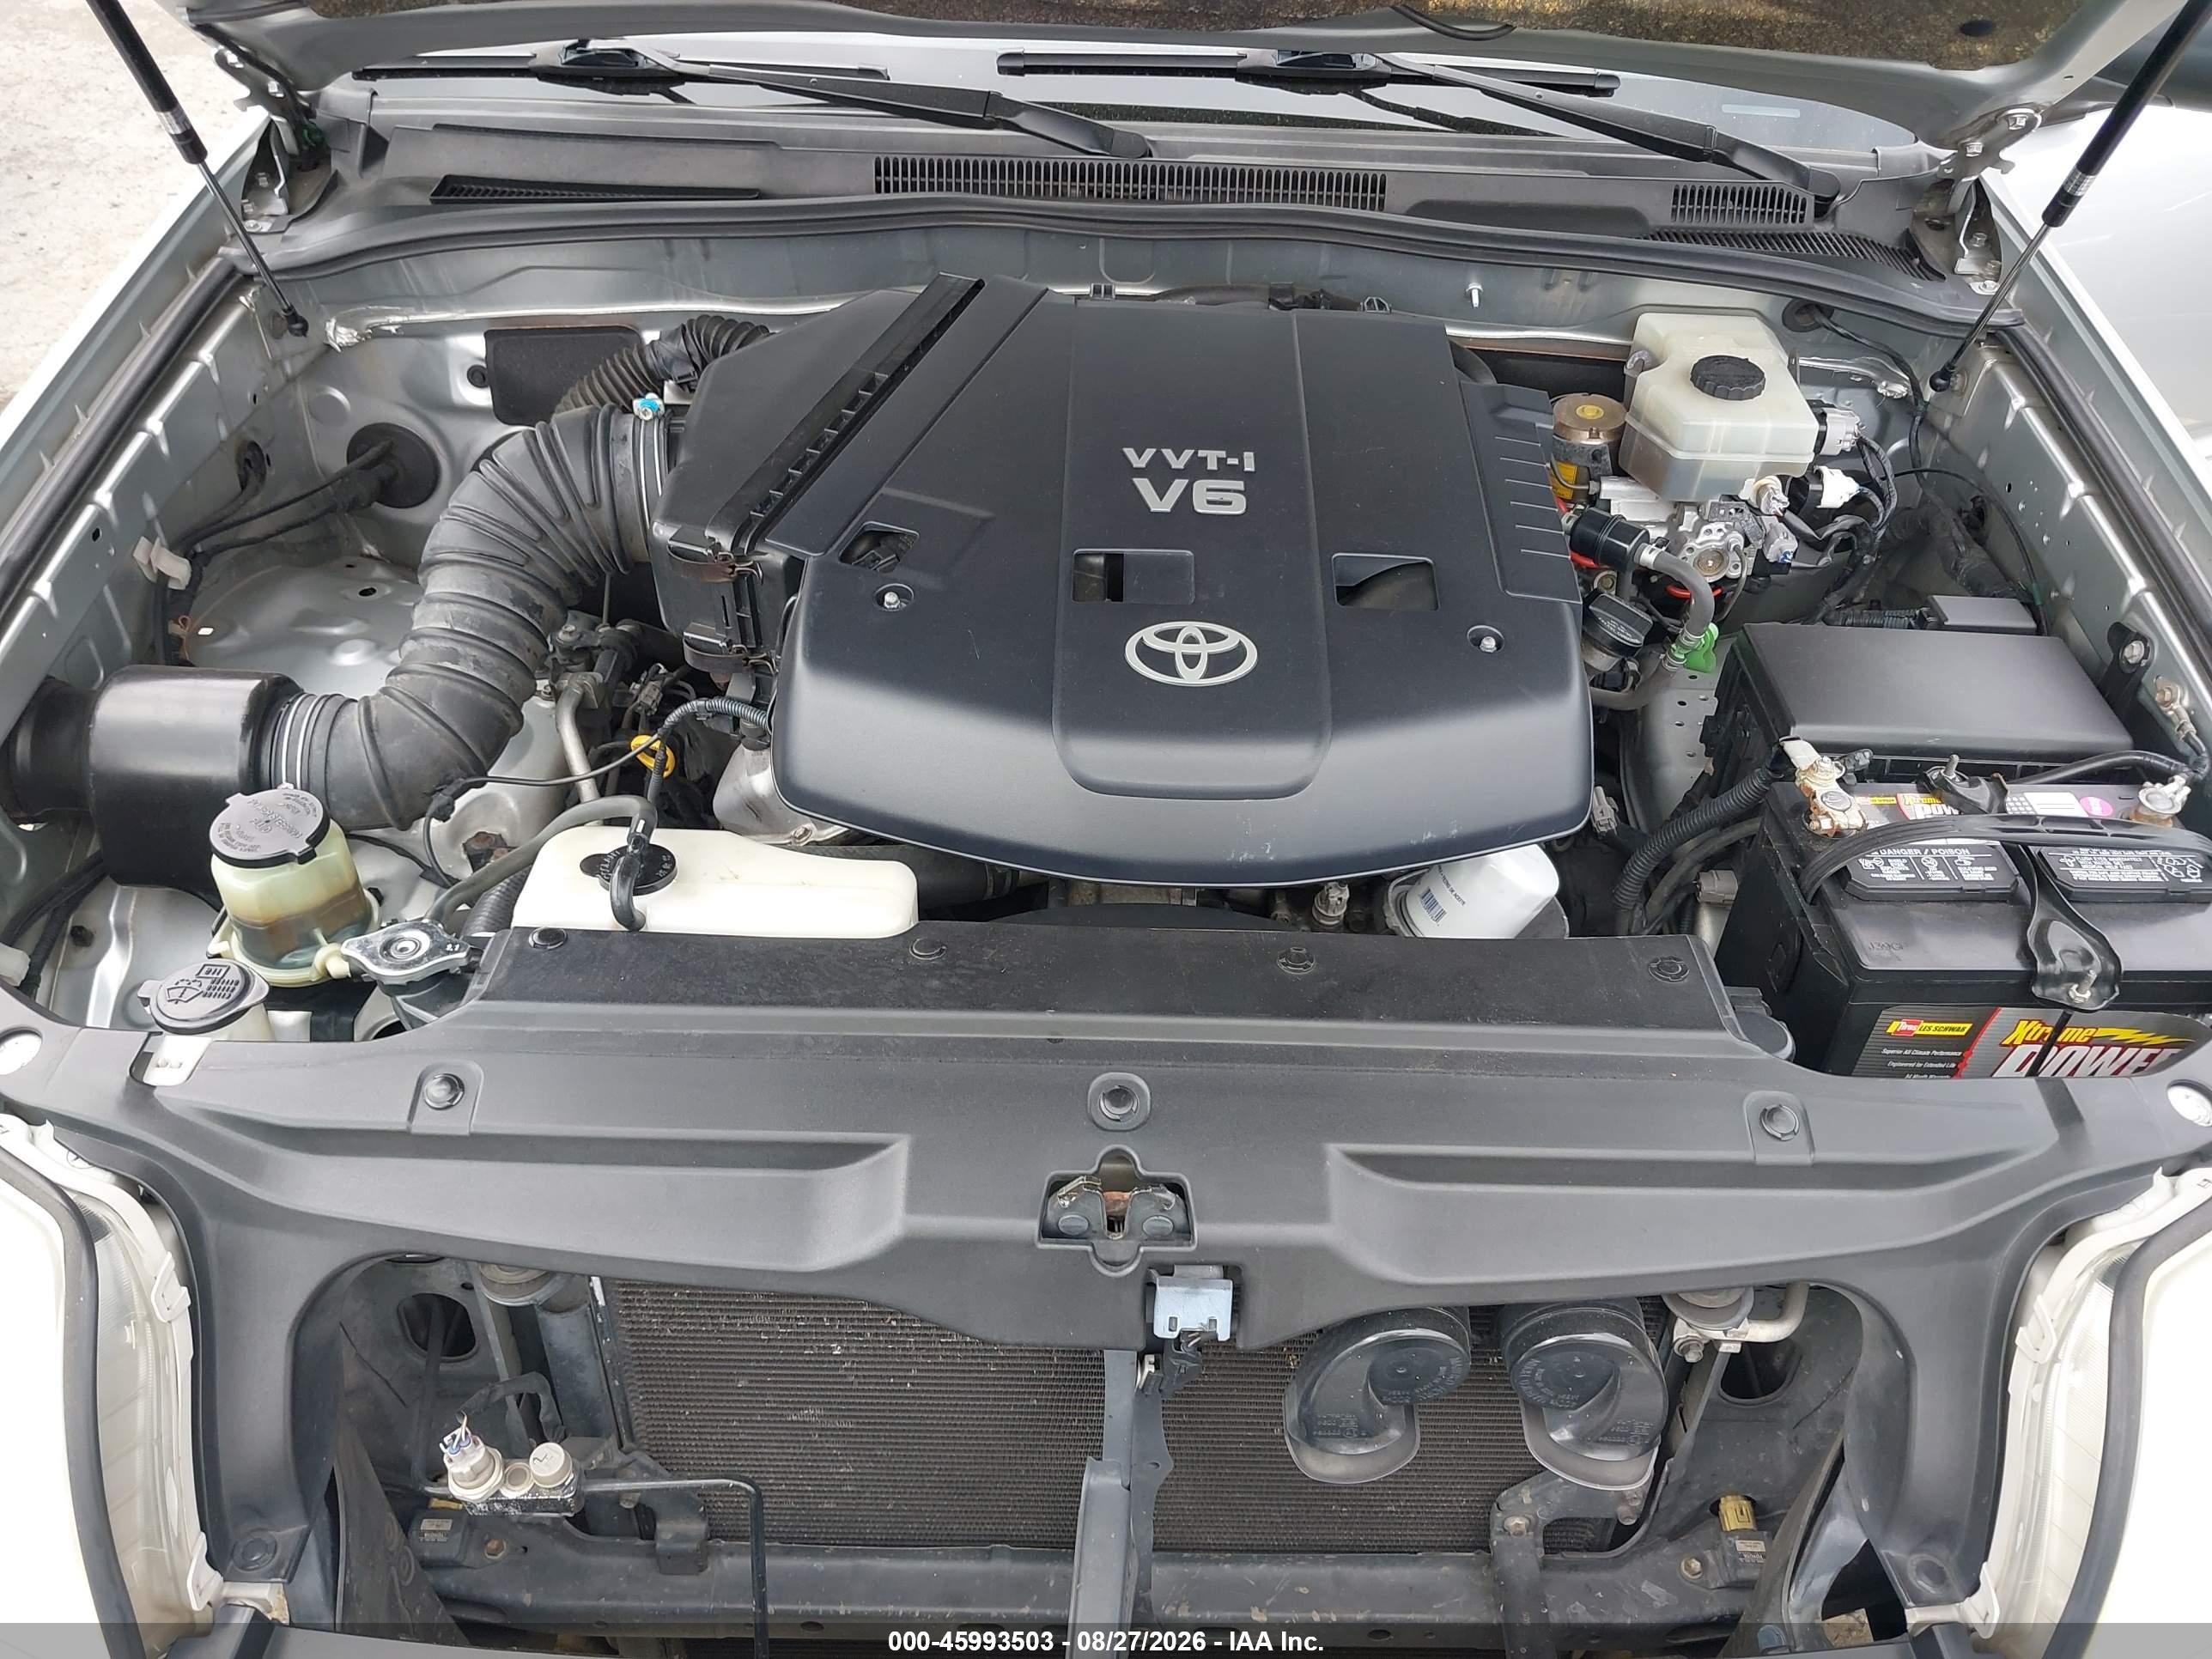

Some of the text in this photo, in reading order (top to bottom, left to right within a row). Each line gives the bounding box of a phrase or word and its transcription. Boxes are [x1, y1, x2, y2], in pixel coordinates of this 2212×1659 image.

[1122, 447, 1255, 471] VVT-I
[1132, 477, 1247, 515] V6
[2002, 1019, 2096, 1045] Xtrme
[1881, 1048, 1903, 1056] Superior
[1887, 1060, 1916, 1068] Engineered
